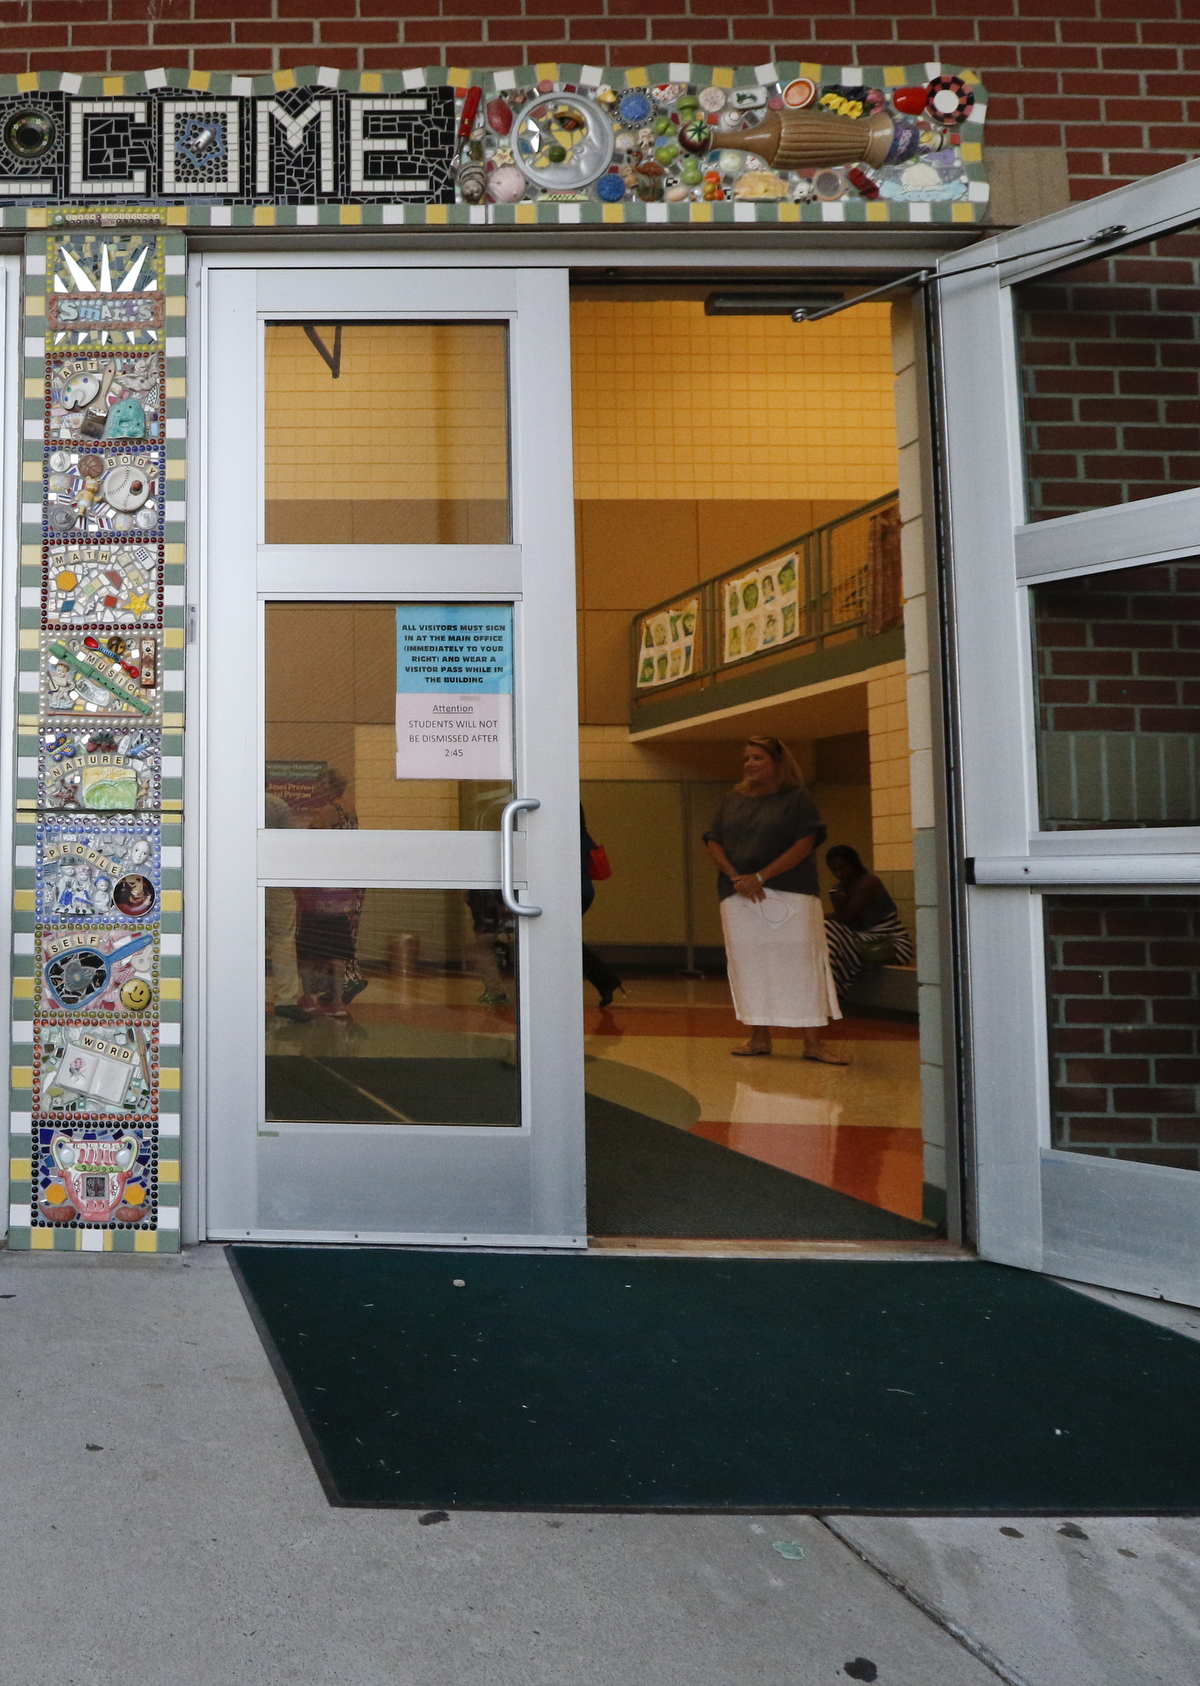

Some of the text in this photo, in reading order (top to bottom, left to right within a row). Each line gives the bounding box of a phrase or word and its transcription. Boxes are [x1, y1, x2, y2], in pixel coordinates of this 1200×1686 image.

[62, 361, 97, 378] ART
[107, 455, 157, 475] BODY
[54, 551, 109, 564] MATH
[86, 654, 136, 693] MUSIC
[432, 704, 474, 713] Attention
[408, 720, 498, 728] STUDENTS WILL NOT
[409, 735, 498, 743] BE DISMISSED AFTER
[444, 749, 463, 757] 2:45
[52, 756, 123, 777] NATURE
[48, 845, 119, 875] PEOPLE
[51, 936, 98, 953] SELF
[83, 1037, 131, 1059] WORD
